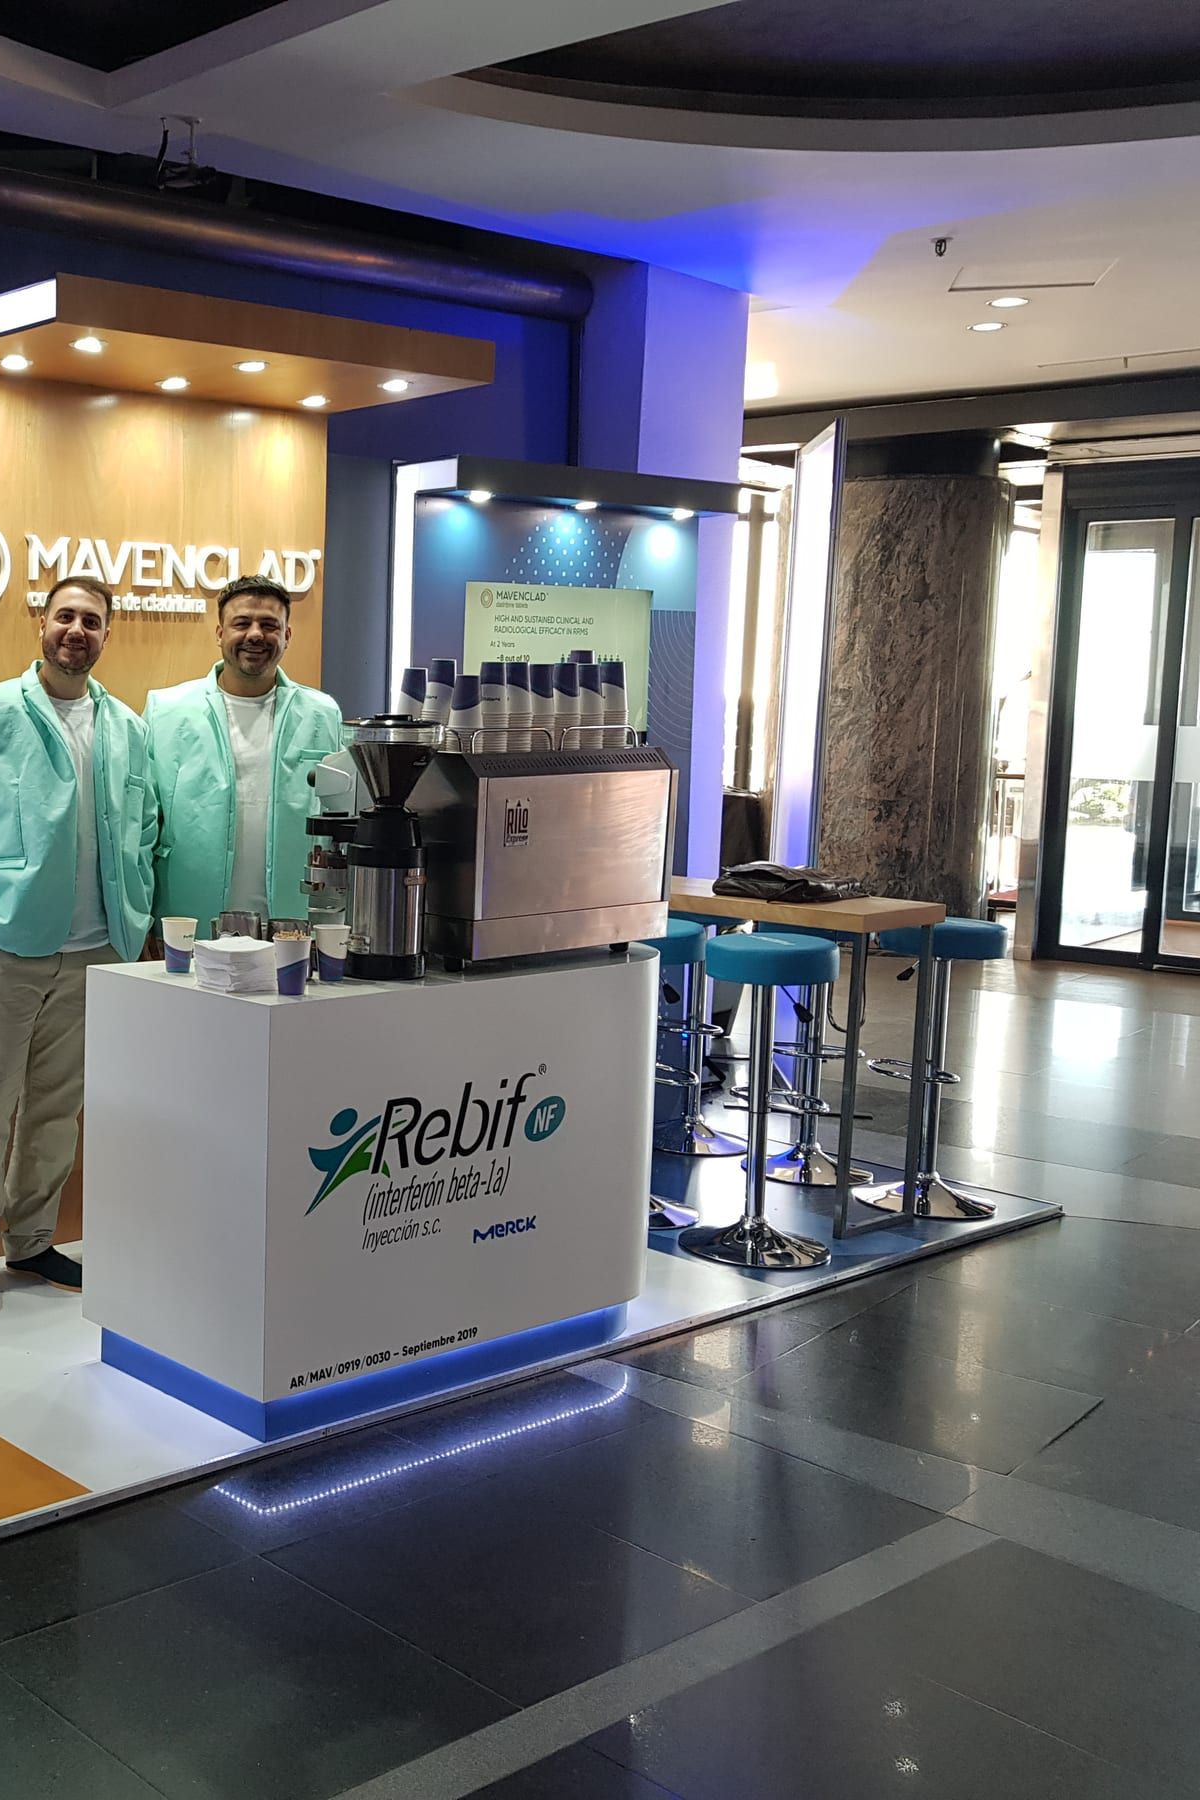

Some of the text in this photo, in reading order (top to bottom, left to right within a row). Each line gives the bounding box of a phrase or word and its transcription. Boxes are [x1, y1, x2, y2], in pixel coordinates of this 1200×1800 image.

[496, 590, 546, 602] MAVENCLAD
[494, 614, 594, 625] HIGH AND SUSTAINED CLINICAL AND
[494, 625, 537, 634] RADIOLOGICAL
[538, 626, 565, 635] EFFICACY
[490, 640, 496, 648] At
[516, 654, 523, 662] of
[523, 654, 530, 662] 10
[533, 1103, 558, 1135] NF
[362, 1171, 445, 1226] (interferón
[362, 1217, 442, 1253] Inyección s.c.
[473, 1215, 537, 1244] MERCK
[289, 1350, 391, 1390] AR/MAV/0919/0030
[402, 1334, 455, 1357] Septiembre
[456, 1326, 478, 1342] 2019
